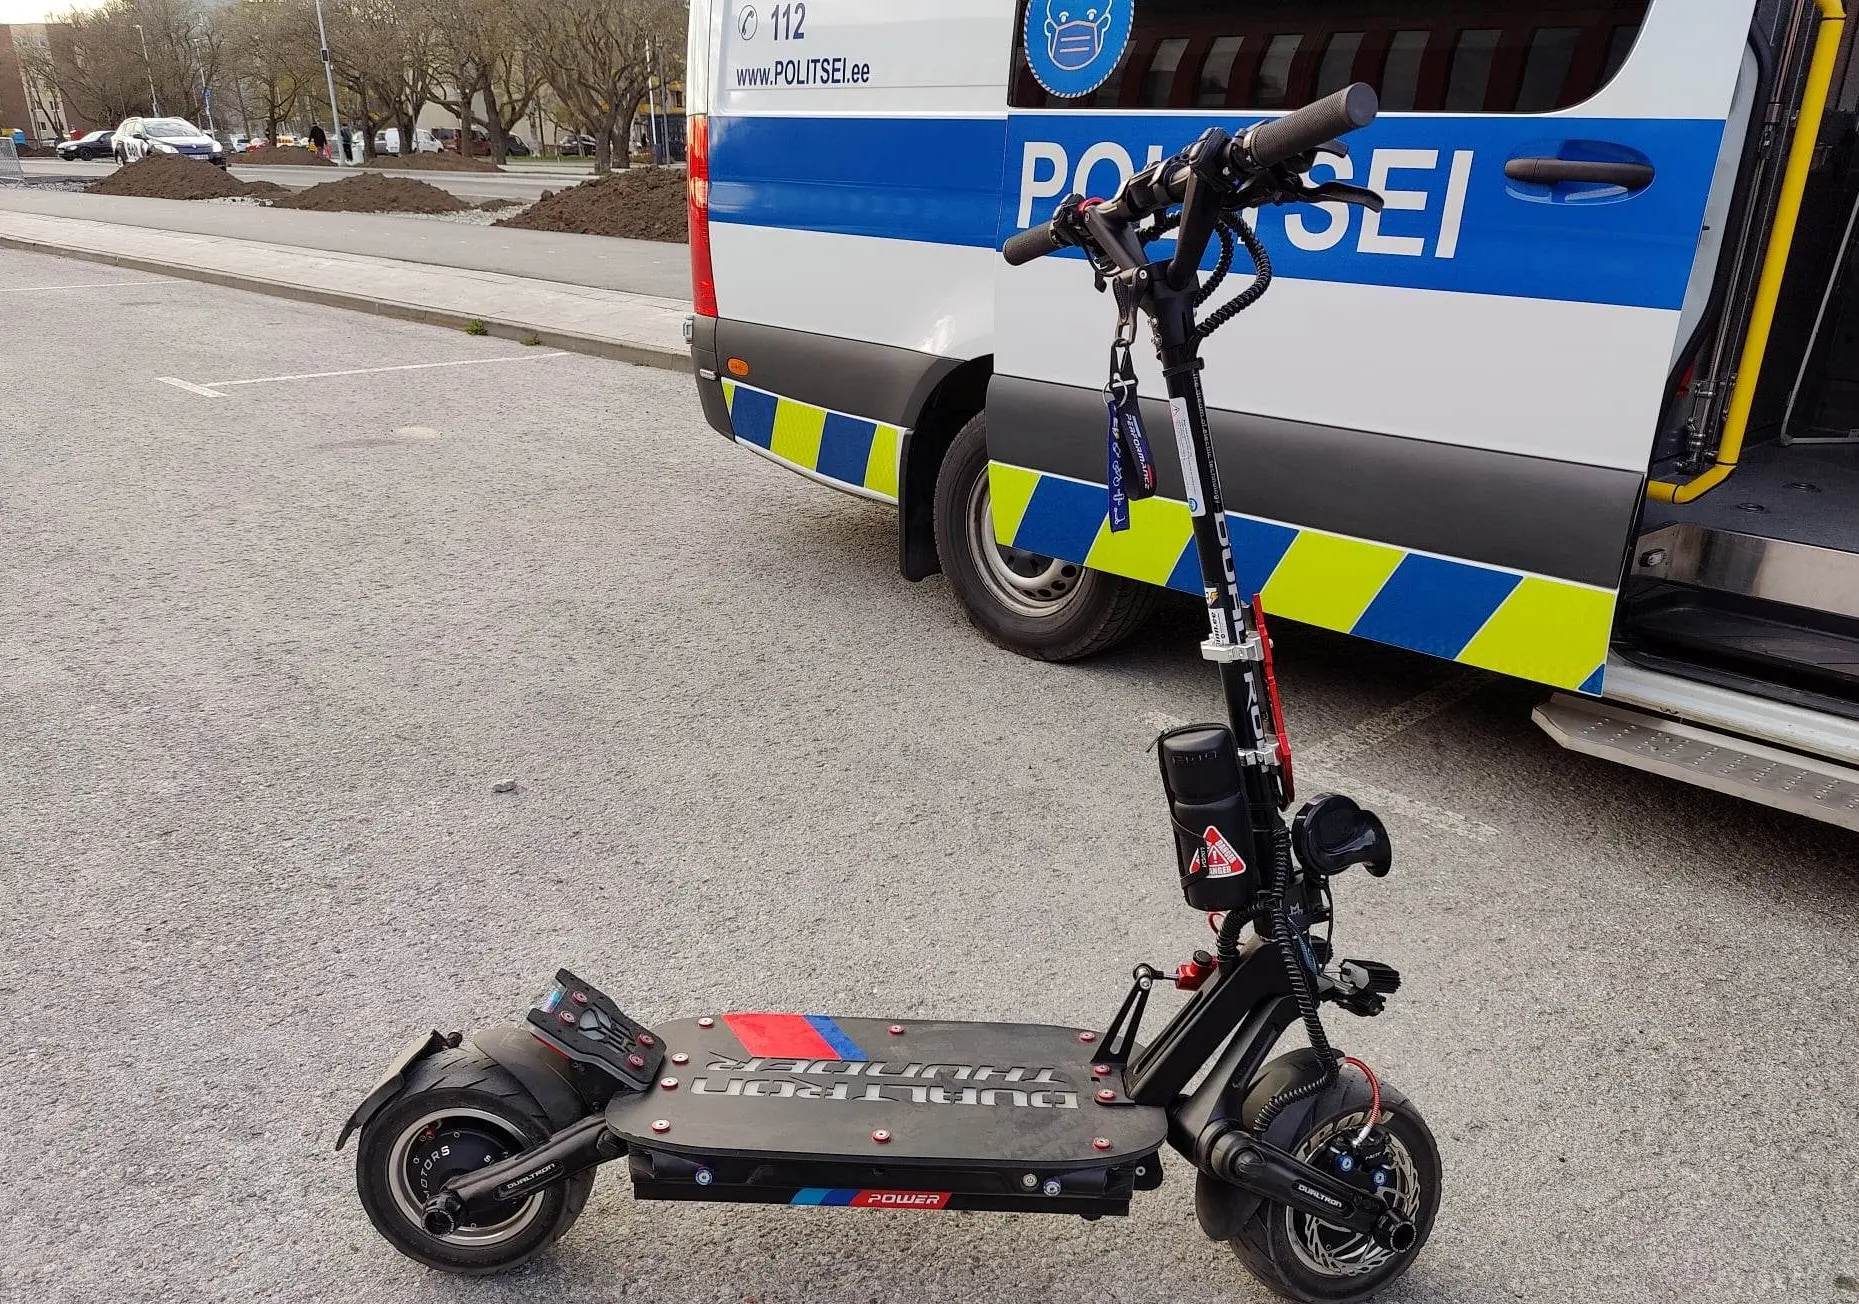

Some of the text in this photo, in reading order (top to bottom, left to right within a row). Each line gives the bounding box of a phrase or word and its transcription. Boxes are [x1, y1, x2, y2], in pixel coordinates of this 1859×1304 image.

[771, 2, 806, 41] 112
[736, 57, 870, 87] www.POLITSEI.ee
[1016, 141, 1474, 259] POSEI
[1125, 413, 1150, 490] PERFORMANCE
[1214, 512, 1270, 773] DUALRO
[1215, 839, 1237, 864] DANGER
[1208, 866, 1232, 875] ANGER
[706, 1051, 1067, 1083] THUNDER
[690, 1076, 1079, 1109] DUALTRON
[506, 1162, 556, 1190] DUALTRON
[868, 1194, 941, 1204] POWER
[1298, 1184, 1342, 1208] DUALTRON
